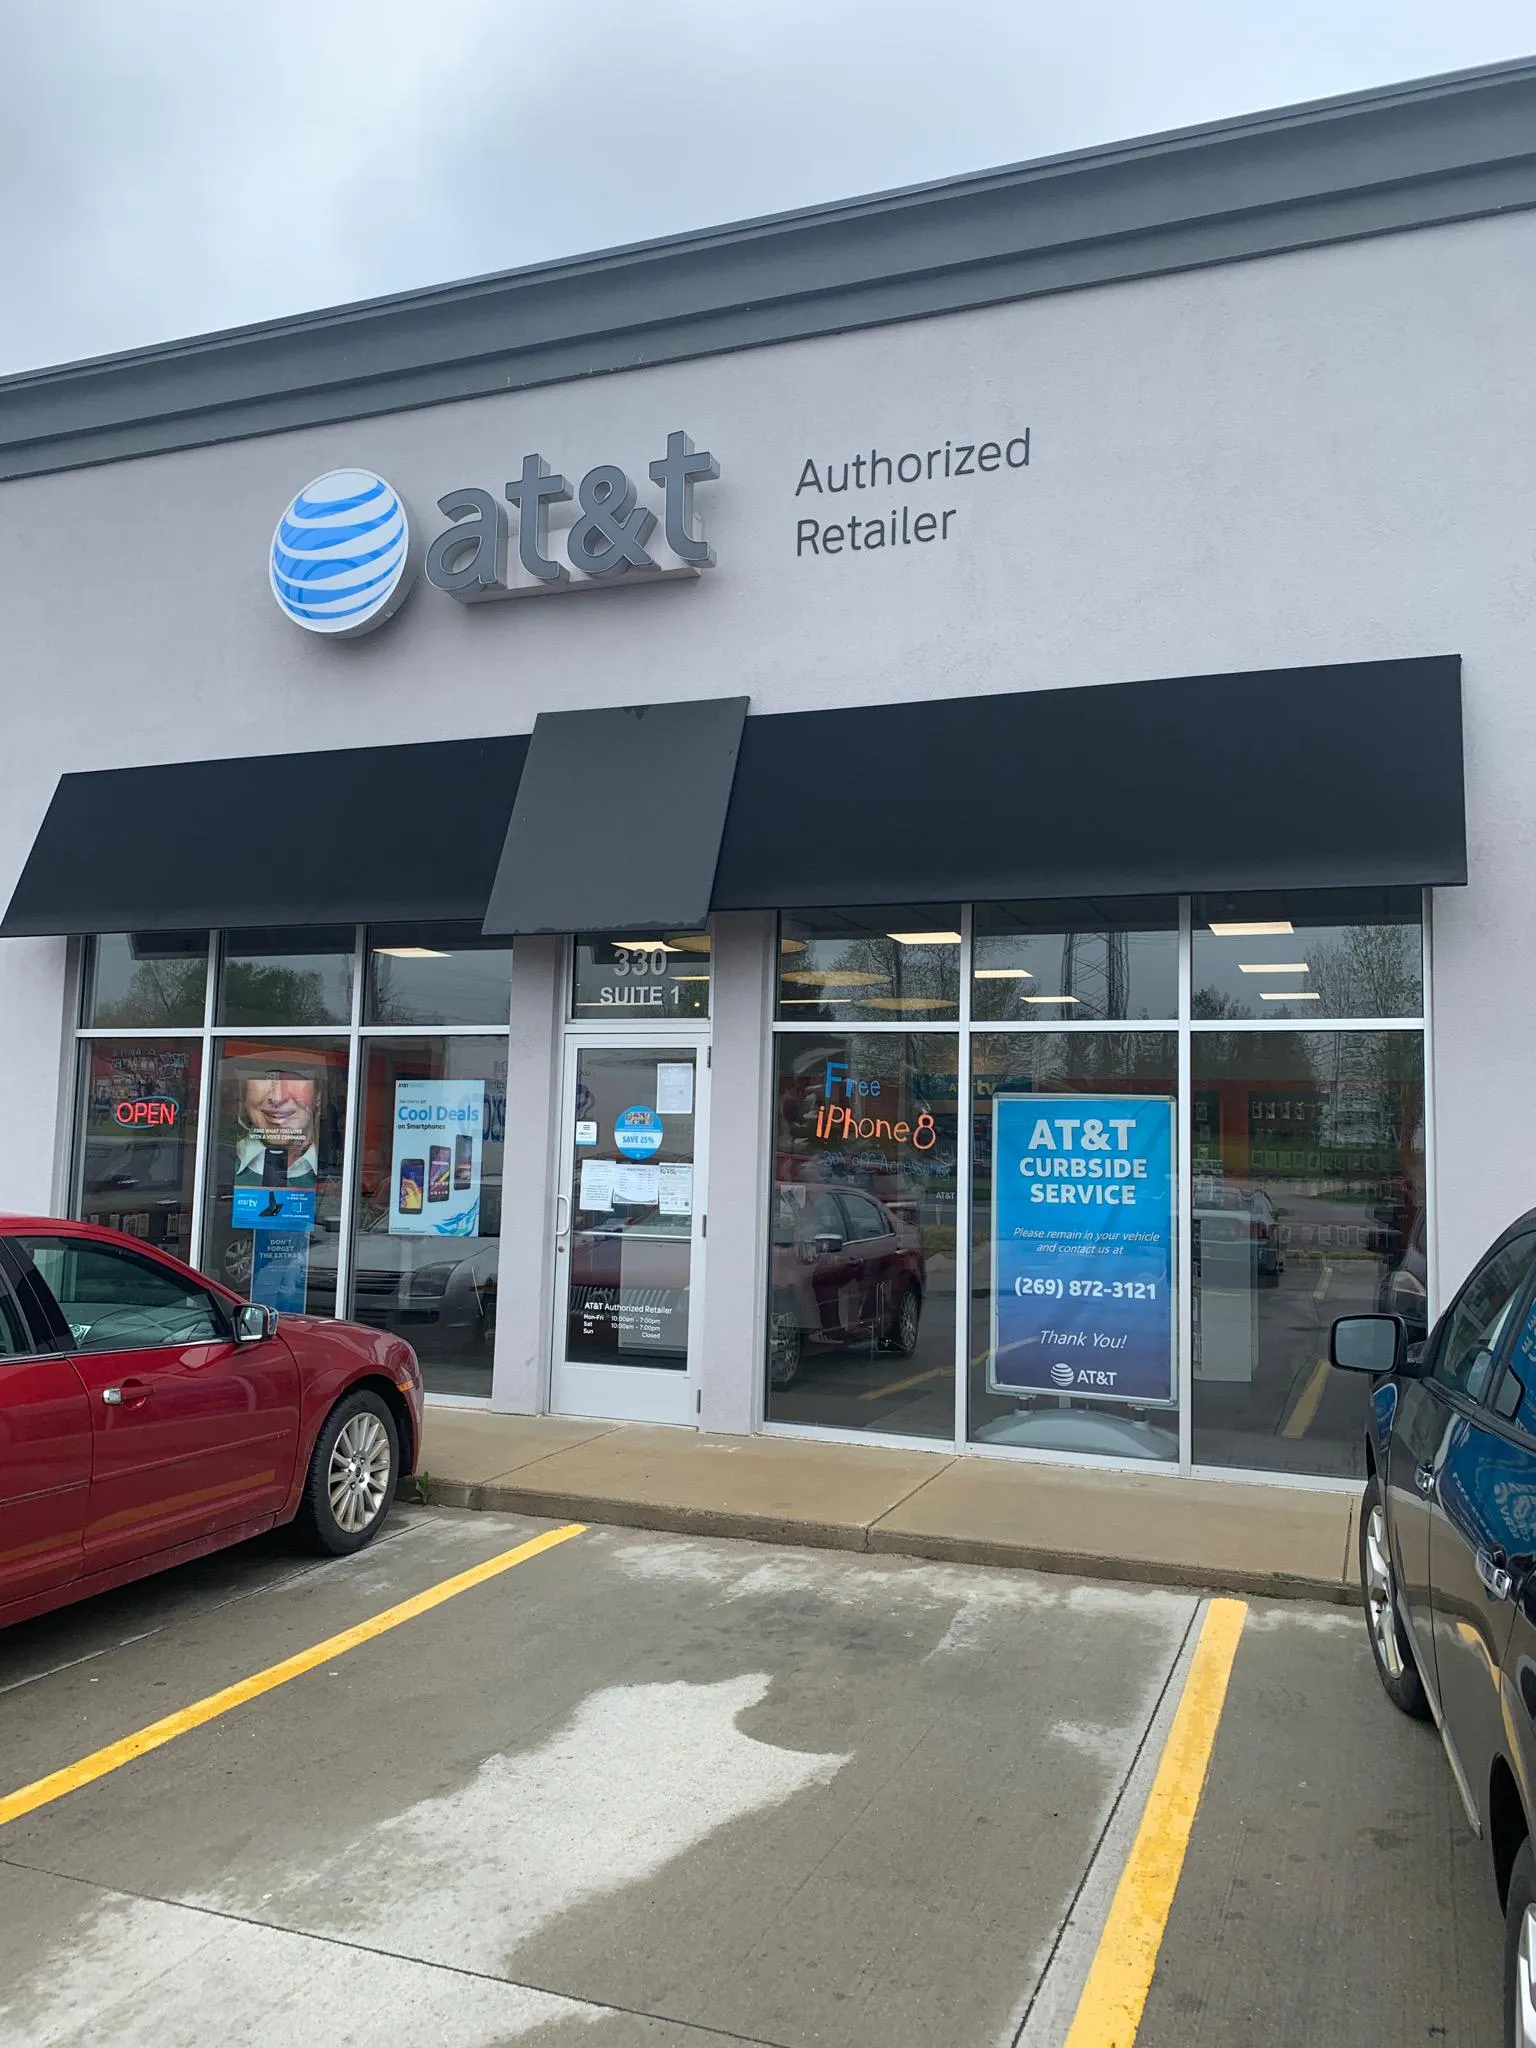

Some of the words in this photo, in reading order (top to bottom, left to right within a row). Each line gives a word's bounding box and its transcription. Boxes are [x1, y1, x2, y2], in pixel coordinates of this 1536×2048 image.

[796, 427, 1031, 496] Authorized
[425, 430, 721, 591] at&t
[796, 505, 957, 557] Retailer
[613, 948, 668, 976] 330
[600, 986, 663, 1005] SUITE
[671, 986, 680, 1004] 1
[825, 1062, 881, 1099] Free
[116, 1101, 176, 1125] OPEN
[398, 1104, 433, 1121] Cool
[437, 1104, 480, 1122] Deals
[407, 1122, 446, 1131] Smartphones
[1028, 1118, 1137, 1151] AT&T
[622, 1135, 640, 1144] SAVE
[640, 1136, 655, 1144] 25%
[1020, 1157, 1148, 1179] CURBSIDE
[1030, 1183, 1137, 1205] SERVICE
[1013, 1227, 1044, 1238] Please
[1046, 1229, 1082, 1240] remain
[1084, 1231, 1094, 1240] in
[1095, 1232, 1120, 1243] your
[1123, 1231, 1160, 1242] vehicle
[1036, 1242, 1057, 1253] and
[1058, 1245, 1096, 1255] contact
[1097, 1246, 1110, 1255] us
[1112, 1246, 1124, 1255] at
[1014, 1276, 1064, 1299] (269)
[1068, 1279, 1156, 1300] 872-3121
[584, 1302, 604, 1310] AT&T
[604, 1303, 644, 1313] Authorized
[645, 1305, 673, 1314] Retailer
[1040, 1329, 1087, 1347] Thank
[1092, 1332, 1128, 1349] You!
[1077, 1369, 1117, 1386] AT&T
